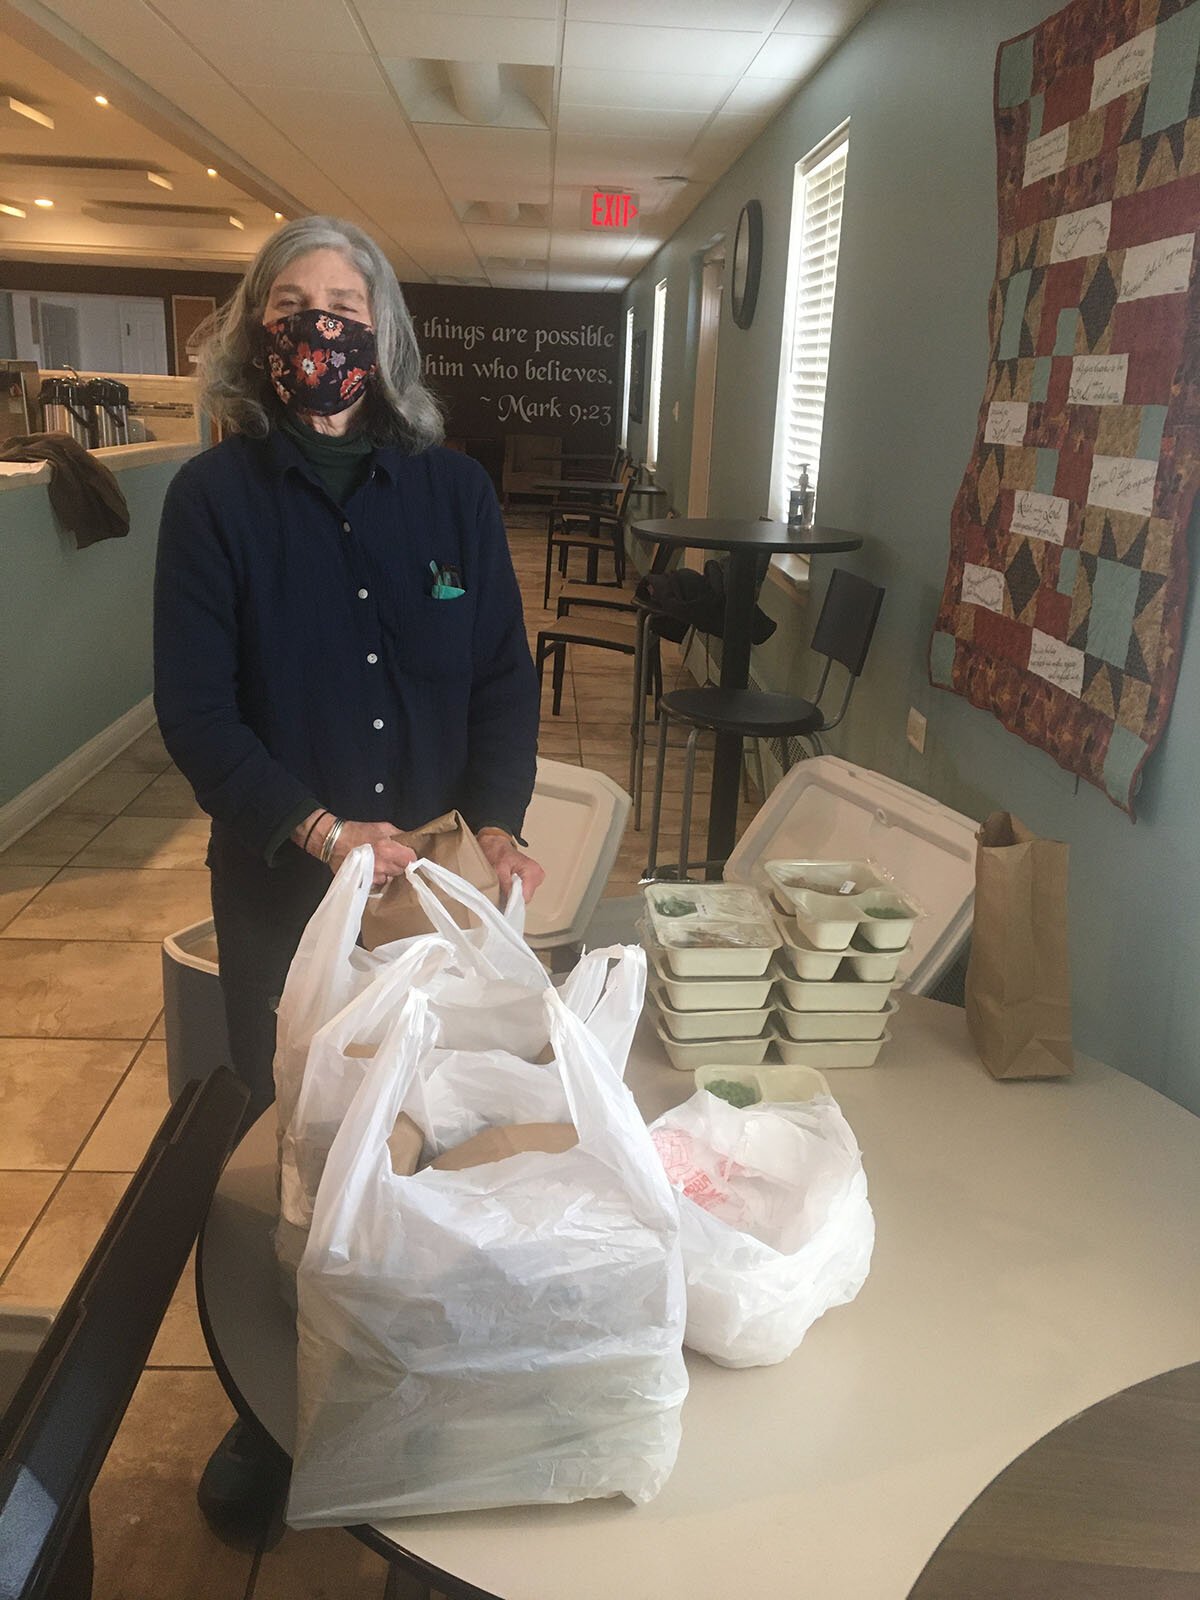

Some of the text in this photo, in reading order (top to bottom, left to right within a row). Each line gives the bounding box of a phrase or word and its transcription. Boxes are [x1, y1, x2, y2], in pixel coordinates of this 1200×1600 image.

[592, 191, 632, 227] EXIT
[423, 316, 485, 350] things
[492, 327, 528, 343] are
[535, 325, 615, 352] possible
[425, 353, 613, 385] him who believes.
[498, 394, 562, 423] Mark
[569, 404, 612, 426] 9:23
